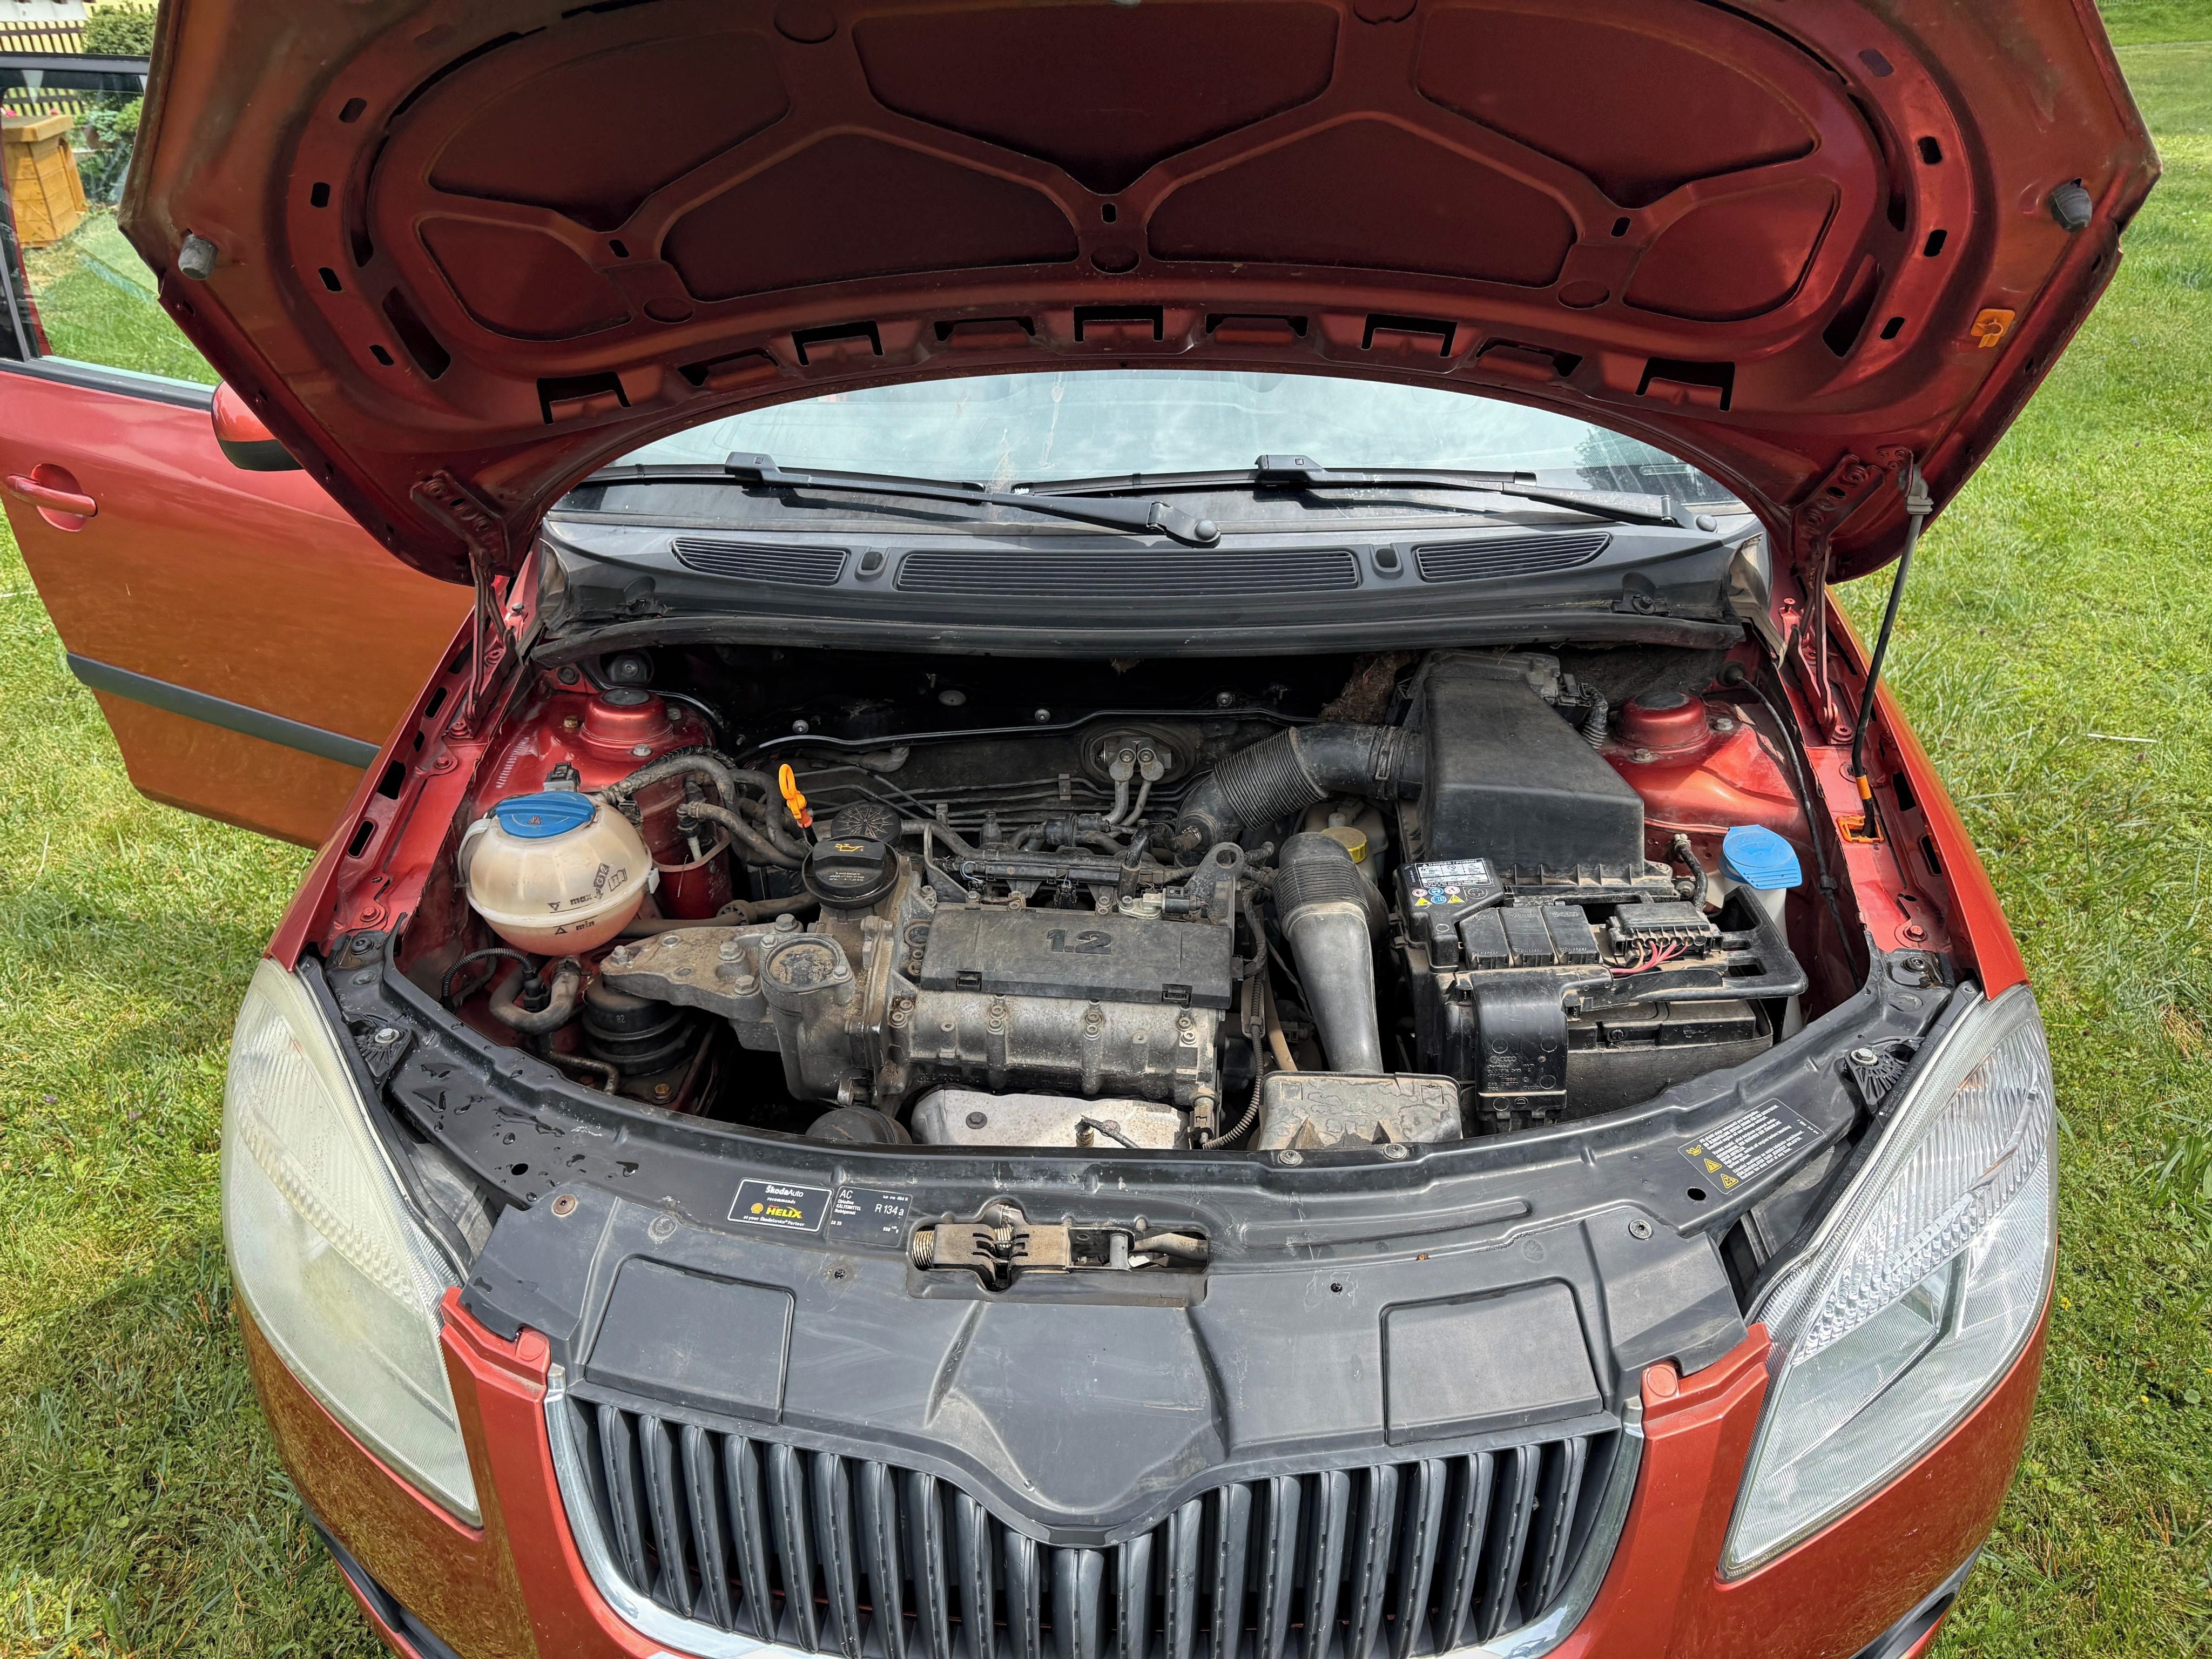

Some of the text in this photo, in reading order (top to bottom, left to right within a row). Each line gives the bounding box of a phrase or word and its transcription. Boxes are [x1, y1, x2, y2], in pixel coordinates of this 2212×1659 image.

[596, 866, 608, 885] G12
[570, 894, 592, 905] max
[576, 921, 595, 930] min
[1046, 929, 1113, 955] 1.2
[765, 1185, 804, 1197] ŠkodaAuto
[839, 1189, 853, 1199] AC
[766, 1206, 802, 1219] HELIX
[875, 1203, 882, 1213] R
[884, 1205, 898, 1215] 134
